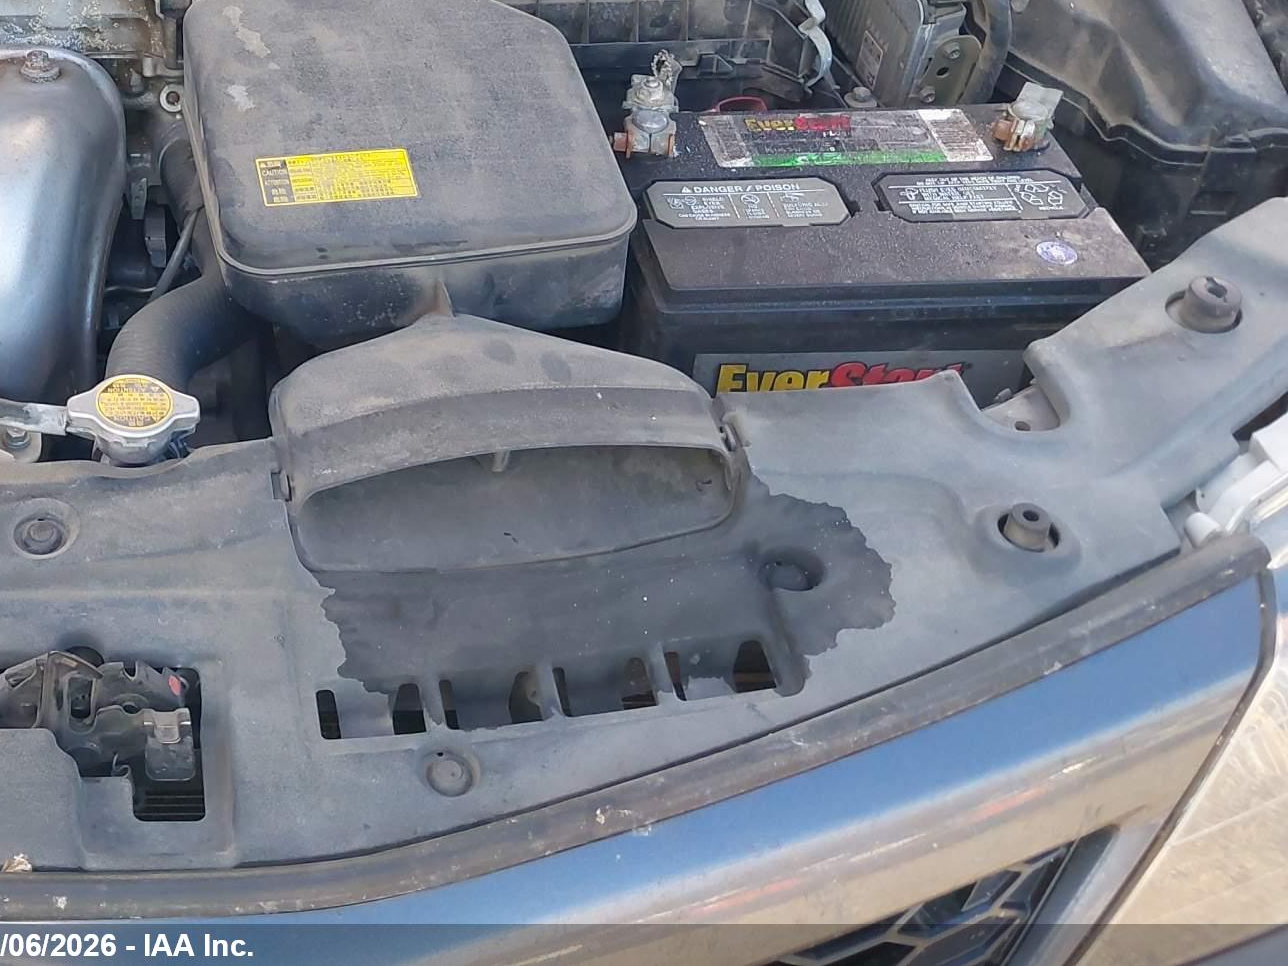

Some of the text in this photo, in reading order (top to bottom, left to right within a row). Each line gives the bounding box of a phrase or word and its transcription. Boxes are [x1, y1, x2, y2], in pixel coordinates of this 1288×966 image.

[693, 186, 743, 194] DANGER
[754, 184, 800, 192] POISON
[716, 361, 964, 394] EverSt
